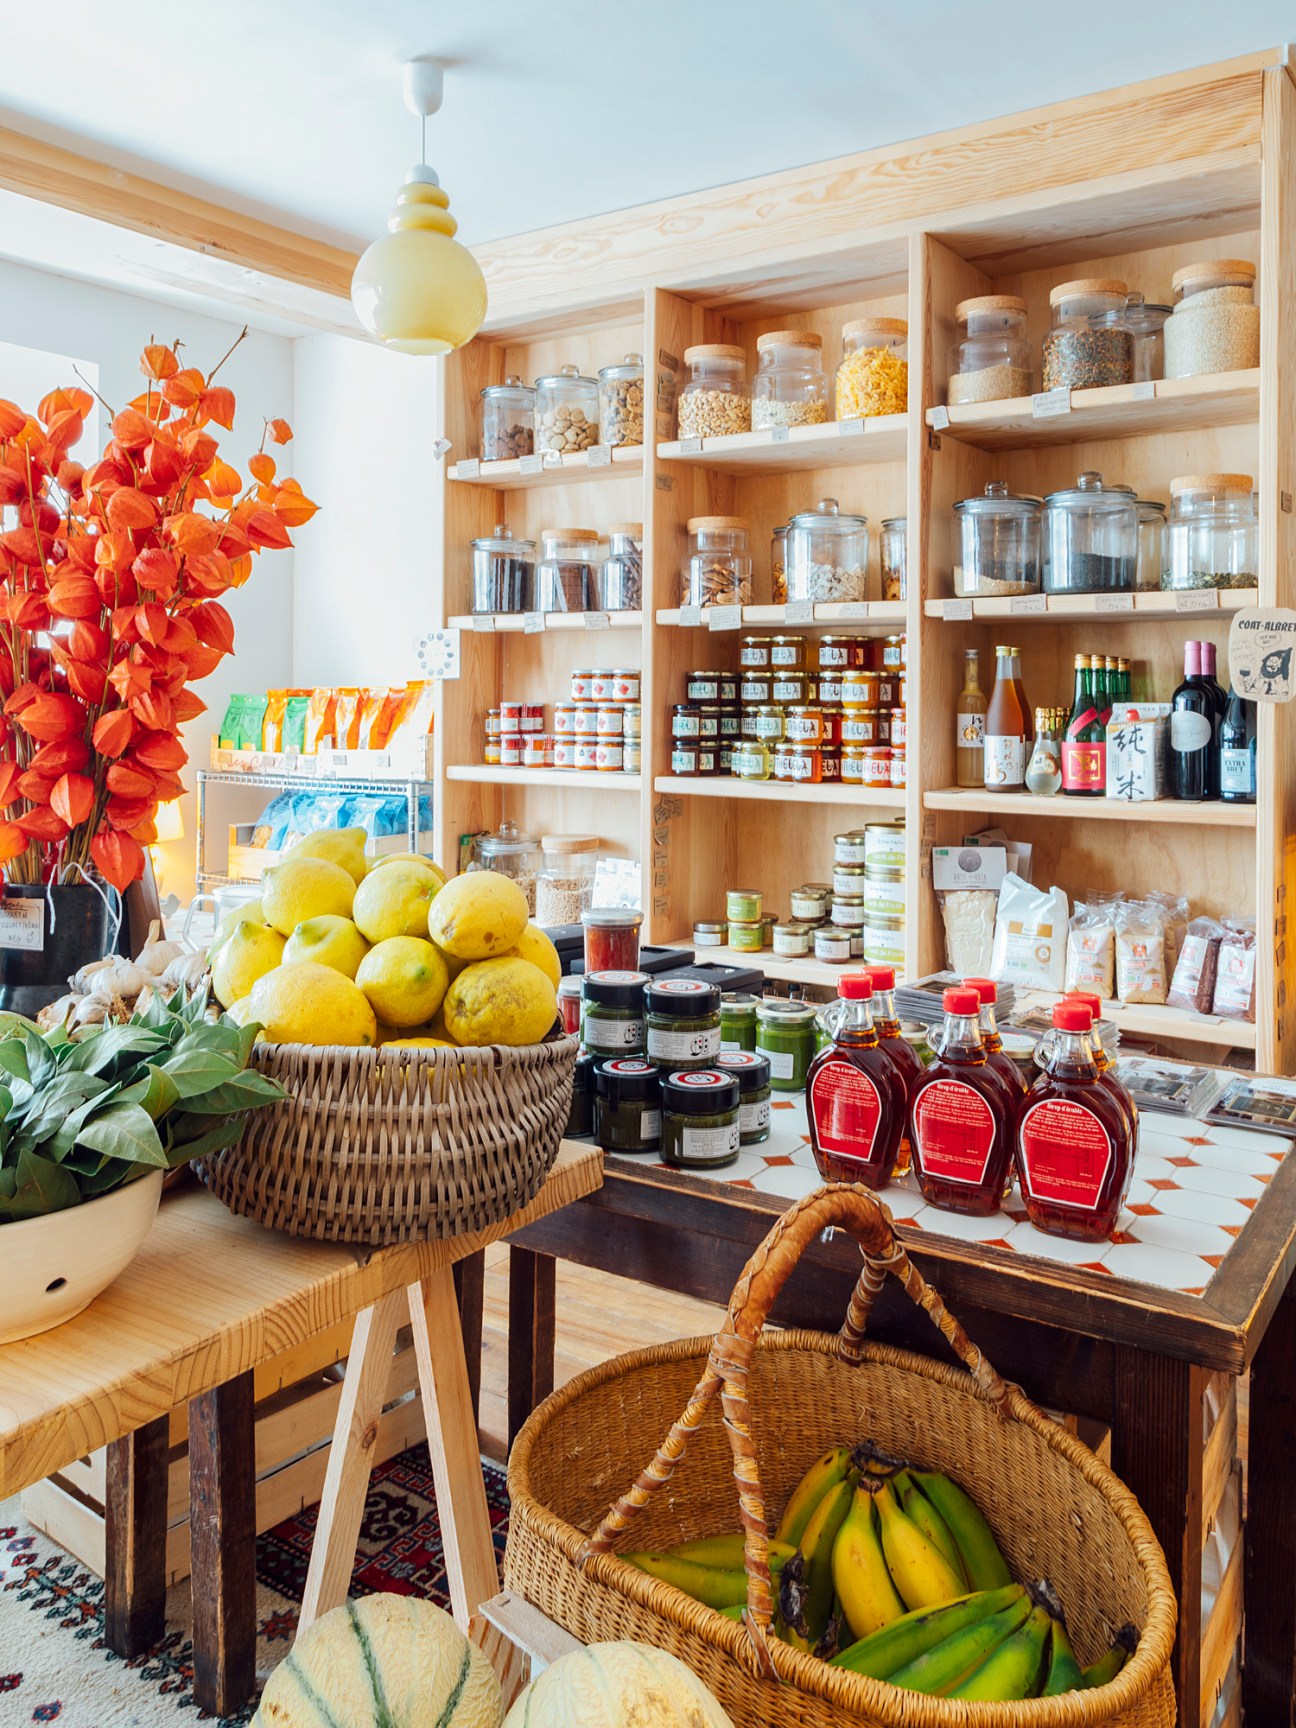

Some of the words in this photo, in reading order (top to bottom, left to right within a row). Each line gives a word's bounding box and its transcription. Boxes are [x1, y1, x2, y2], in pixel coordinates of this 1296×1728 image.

[1238, 620, 1296, 632] COAT-ALBRET
[1113, 725, 1146, 799] 純米
[1046, 1103, 1060, 1112] Sirop
